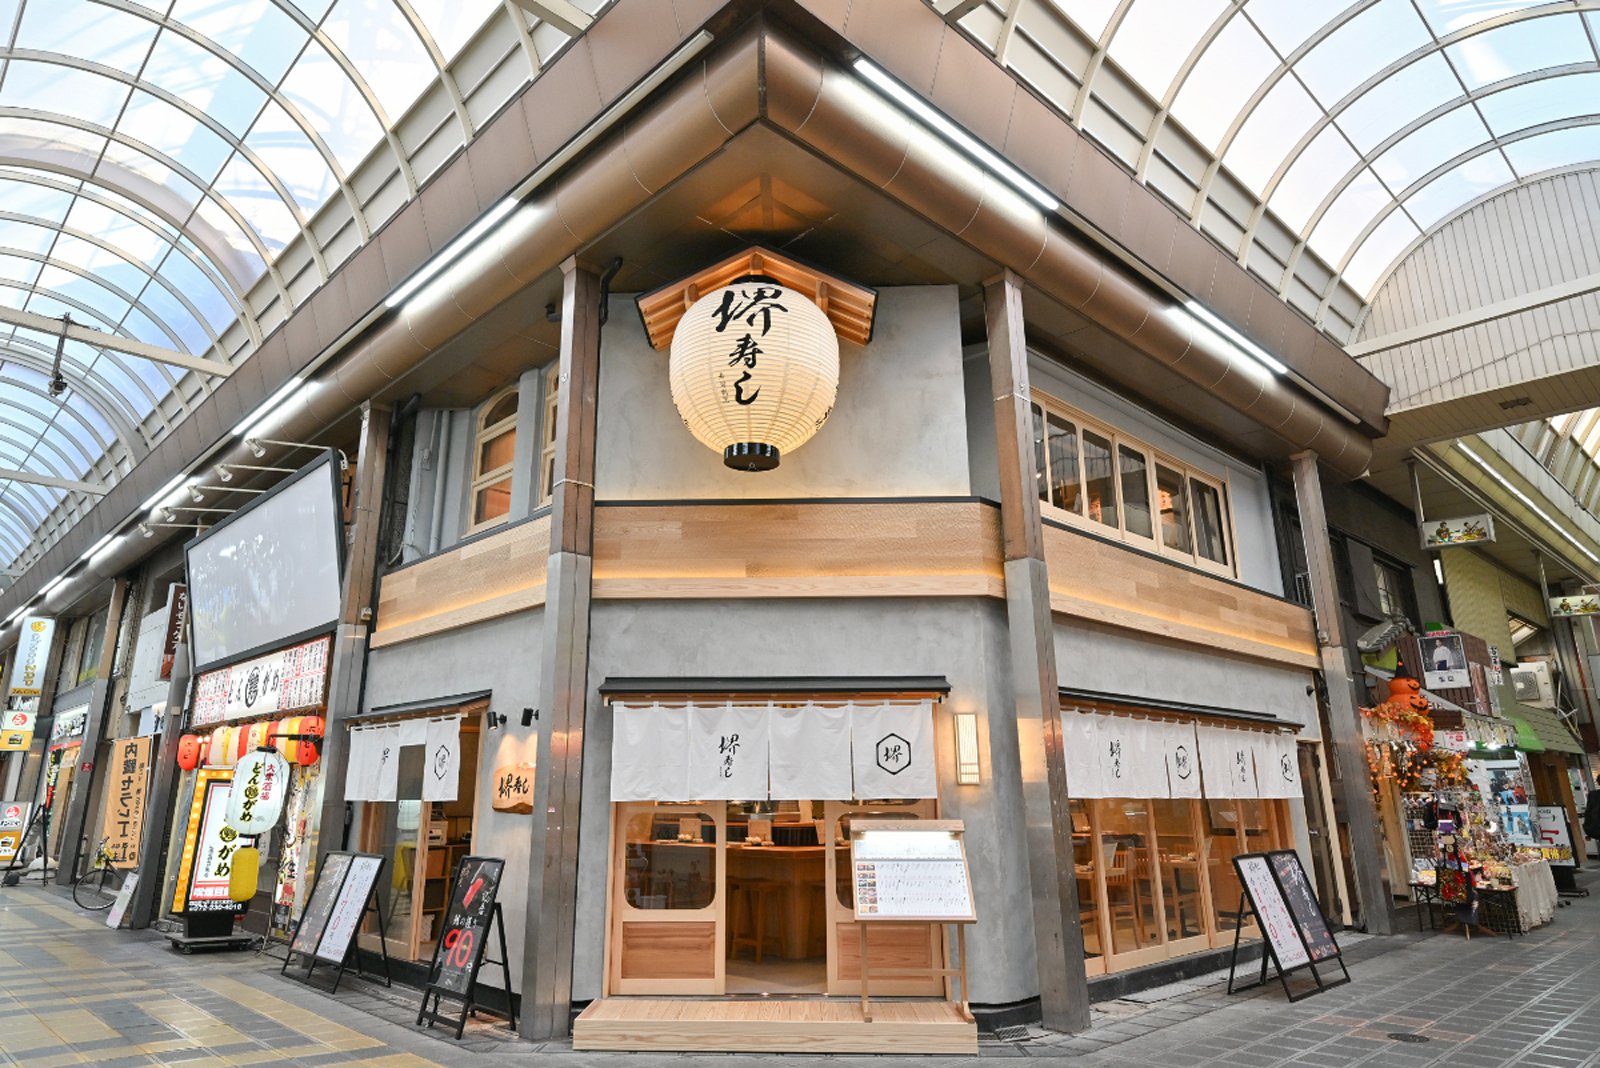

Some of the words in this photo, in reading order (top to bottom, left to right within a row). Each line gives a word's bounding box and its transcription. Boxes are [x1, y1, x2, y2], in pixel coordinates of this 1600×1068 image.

[712, 287, 788, 405] 堺寿し
[718, 733, 740, 778] 堺寿し
[884, 744, 903, 764] 堺
[444, 928, 473, 968] 90
